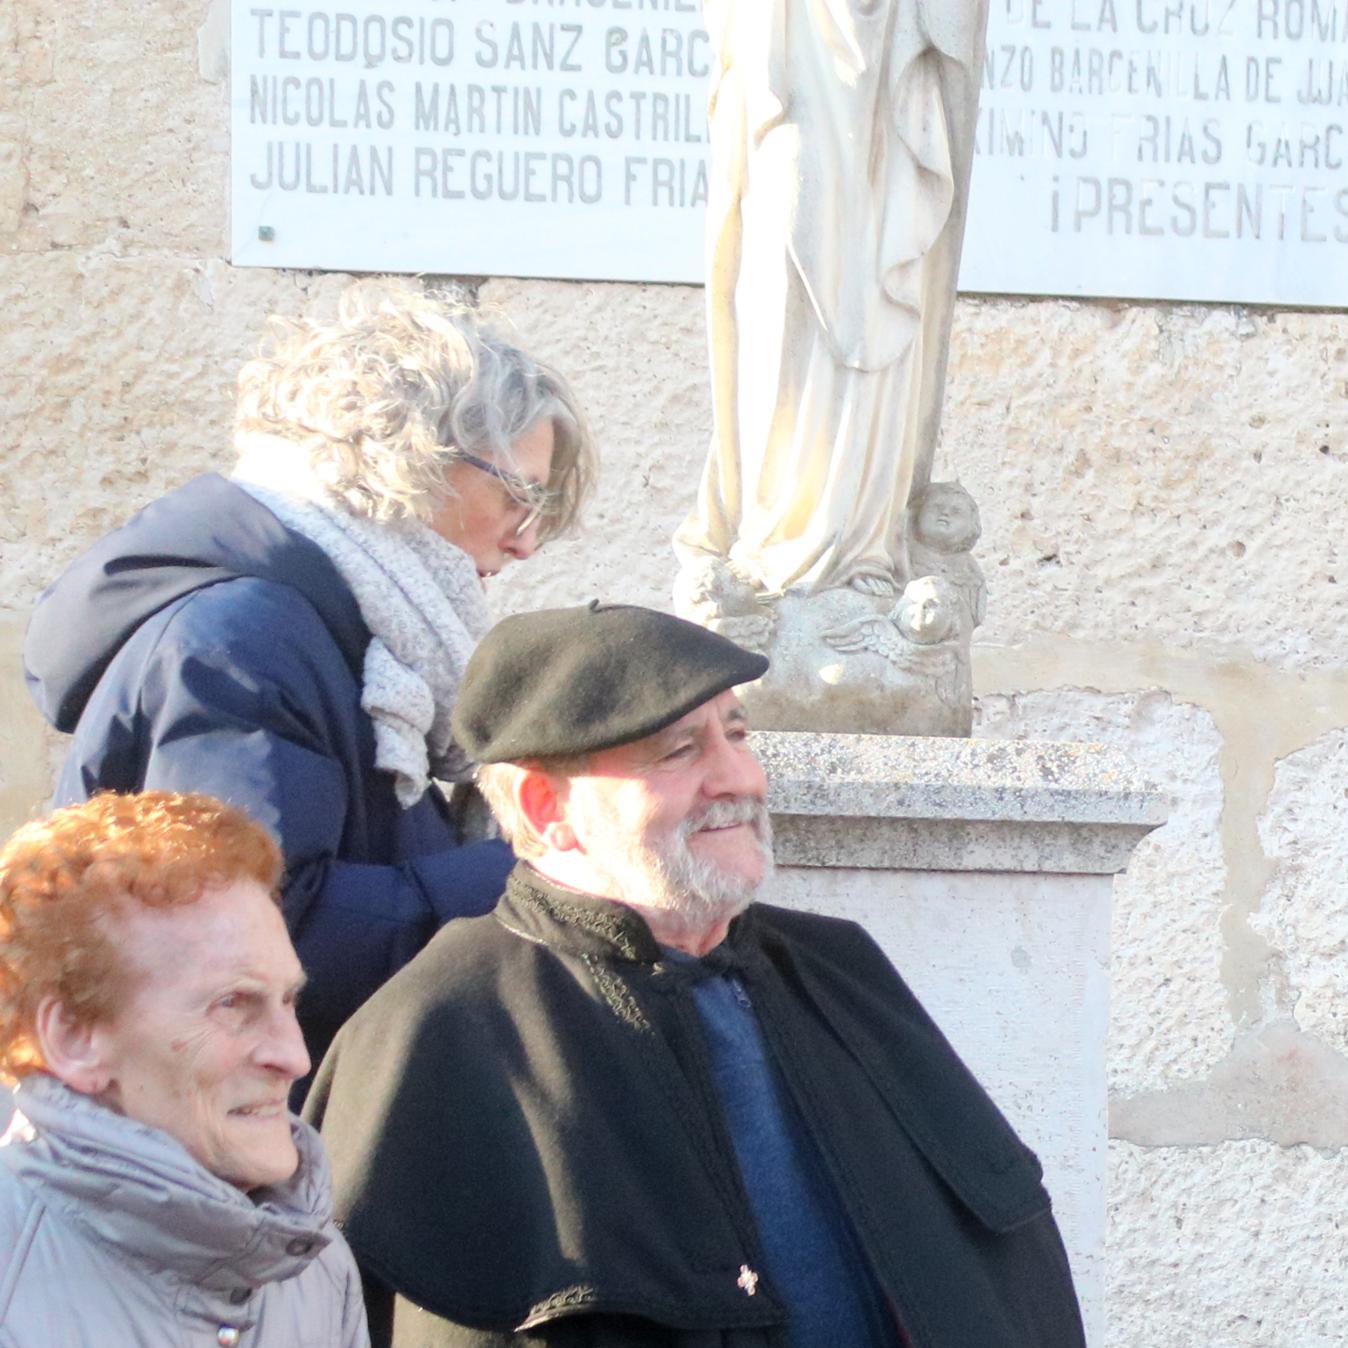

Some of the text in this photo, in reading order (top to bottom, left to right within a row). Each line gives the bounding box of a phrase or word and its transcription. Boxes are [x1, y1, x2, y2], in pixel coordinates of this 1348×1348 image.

[250, 8, 454, 66] TEODOSIO
[475, 19, 583, 72] SANZ
[1006, 0, 1052, 29] DE
[1070, 0, 1117, 34] LA
[1136, 0, 1234, 37] CRUZ
[1050, 46, 1231, 101] BARCENILLA
[1246, 56, 1283, 104] DE
[250, 74, 711, 143] NICOLAS MARTIN CASTRIL
[1111, 113, 1222, 166] FRIAS
[250, 141, 393, 196] JULIAN
[414, 146, 602, 205] REGUERO
